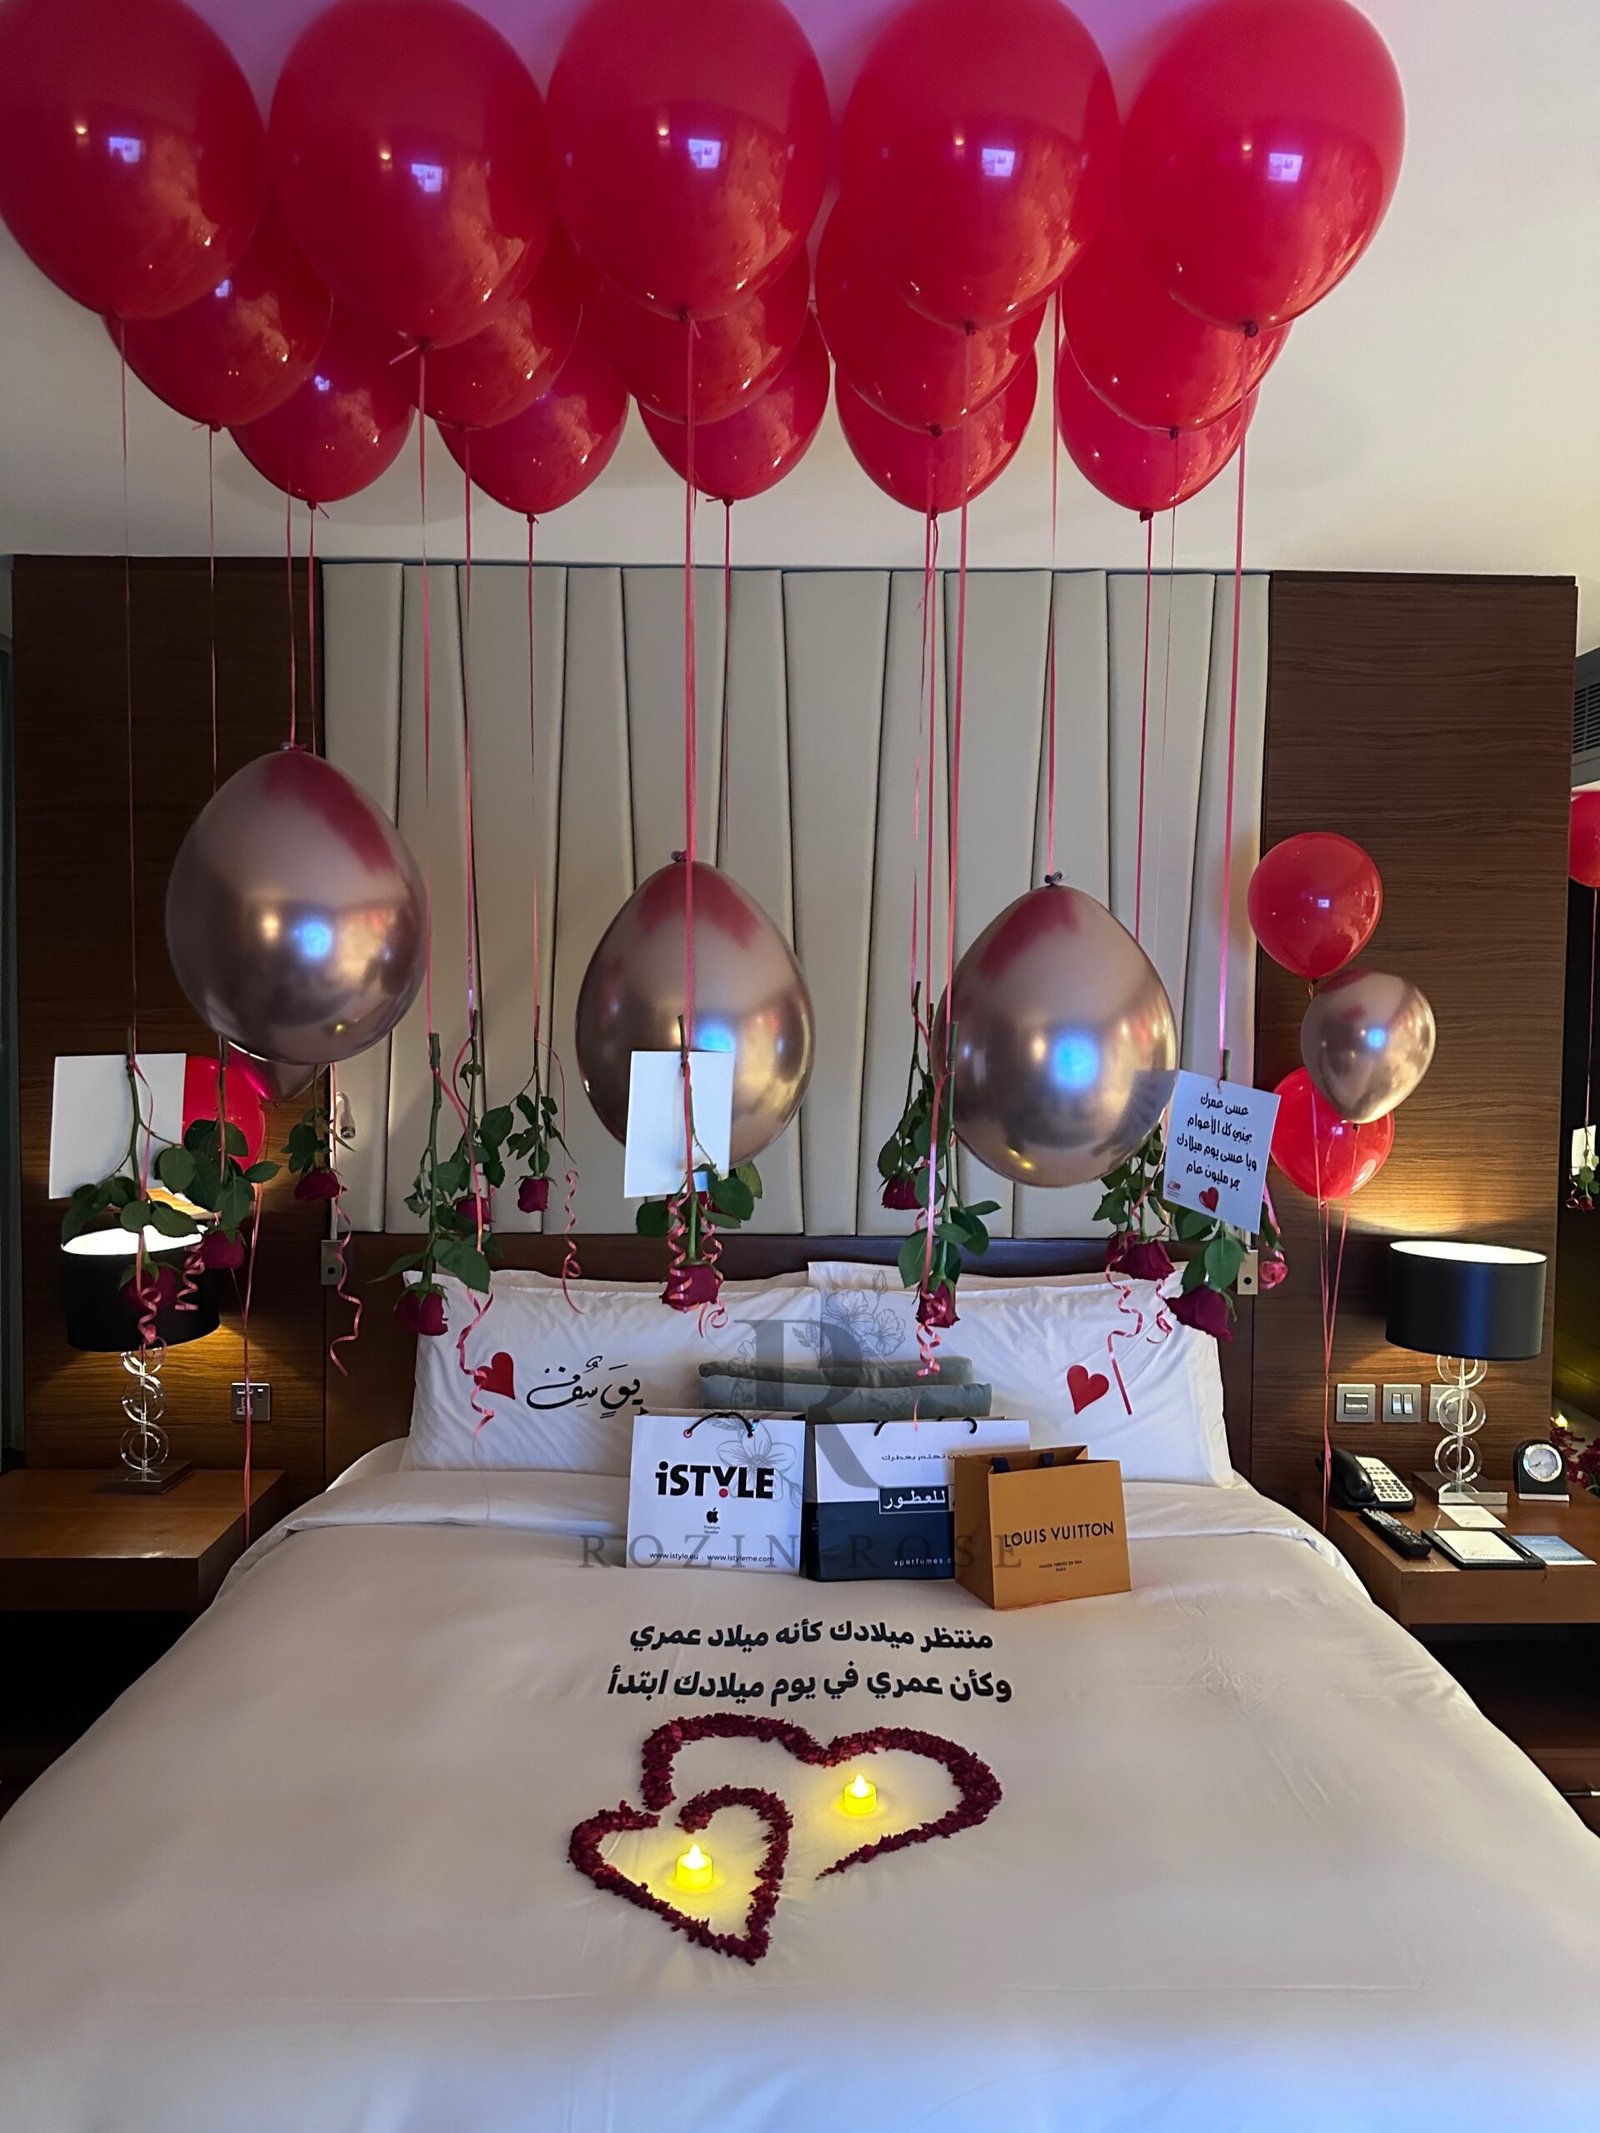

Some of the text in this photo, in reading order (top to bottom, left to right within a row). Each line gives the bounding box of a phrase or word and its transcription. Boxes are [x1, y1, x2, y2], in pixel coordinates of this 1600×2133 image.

[1200, 1092, 1249, 1116] عسى عمرك
[1222, 1121, 1232, 1137] كل
[1176, 1132, 1257, 1171] ويا عسى يوم ميلادك
[1186, 1160, 1203, 1174] عام
[1204, 1164, 1229, 1185] مليون
[655, 1460, 775, 1500] iSTYLE
[883, 1489, 946, 1510] للعطور
[1004, 1521, 1114, 1548] LOUIS VUITTON
[649, 1552, 775, 1563] www.istyle.eu www.istyleme.com
[630, 1618, 994, 1653] منتظر ميلادك كأنه ميلاد عمري
[607, 1660, 1013, 1707] وكأن عمري في يوم ميلادك ابتدأ
